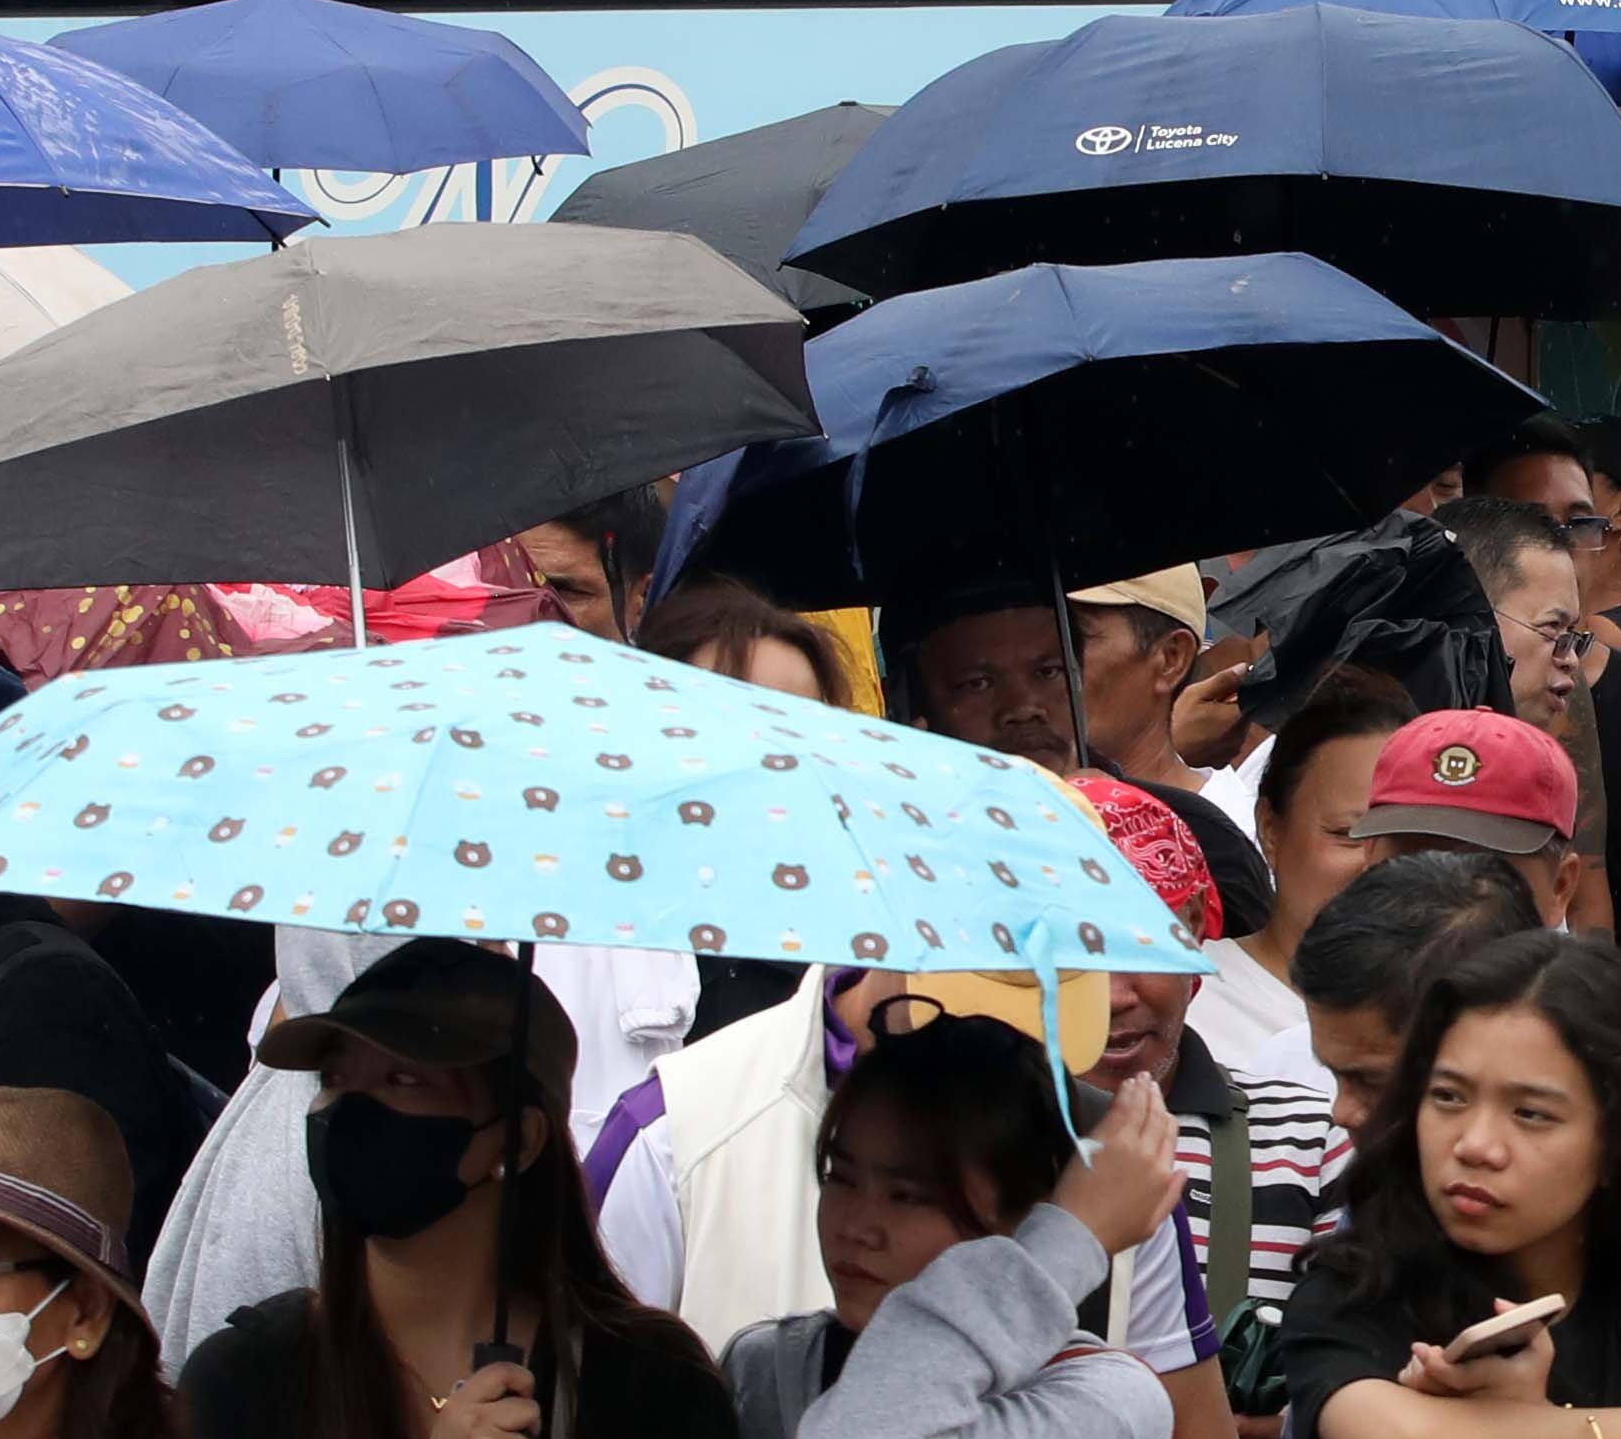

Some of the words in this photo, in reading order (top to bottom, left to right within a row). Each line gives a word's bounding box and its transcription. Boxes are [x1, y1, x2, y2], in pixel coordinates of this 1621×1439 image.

[1150, 125, 1203, 138] Toyota
[1146, 138, 1203, 150] Lucena
[1206, 133, 1239, 147] City
